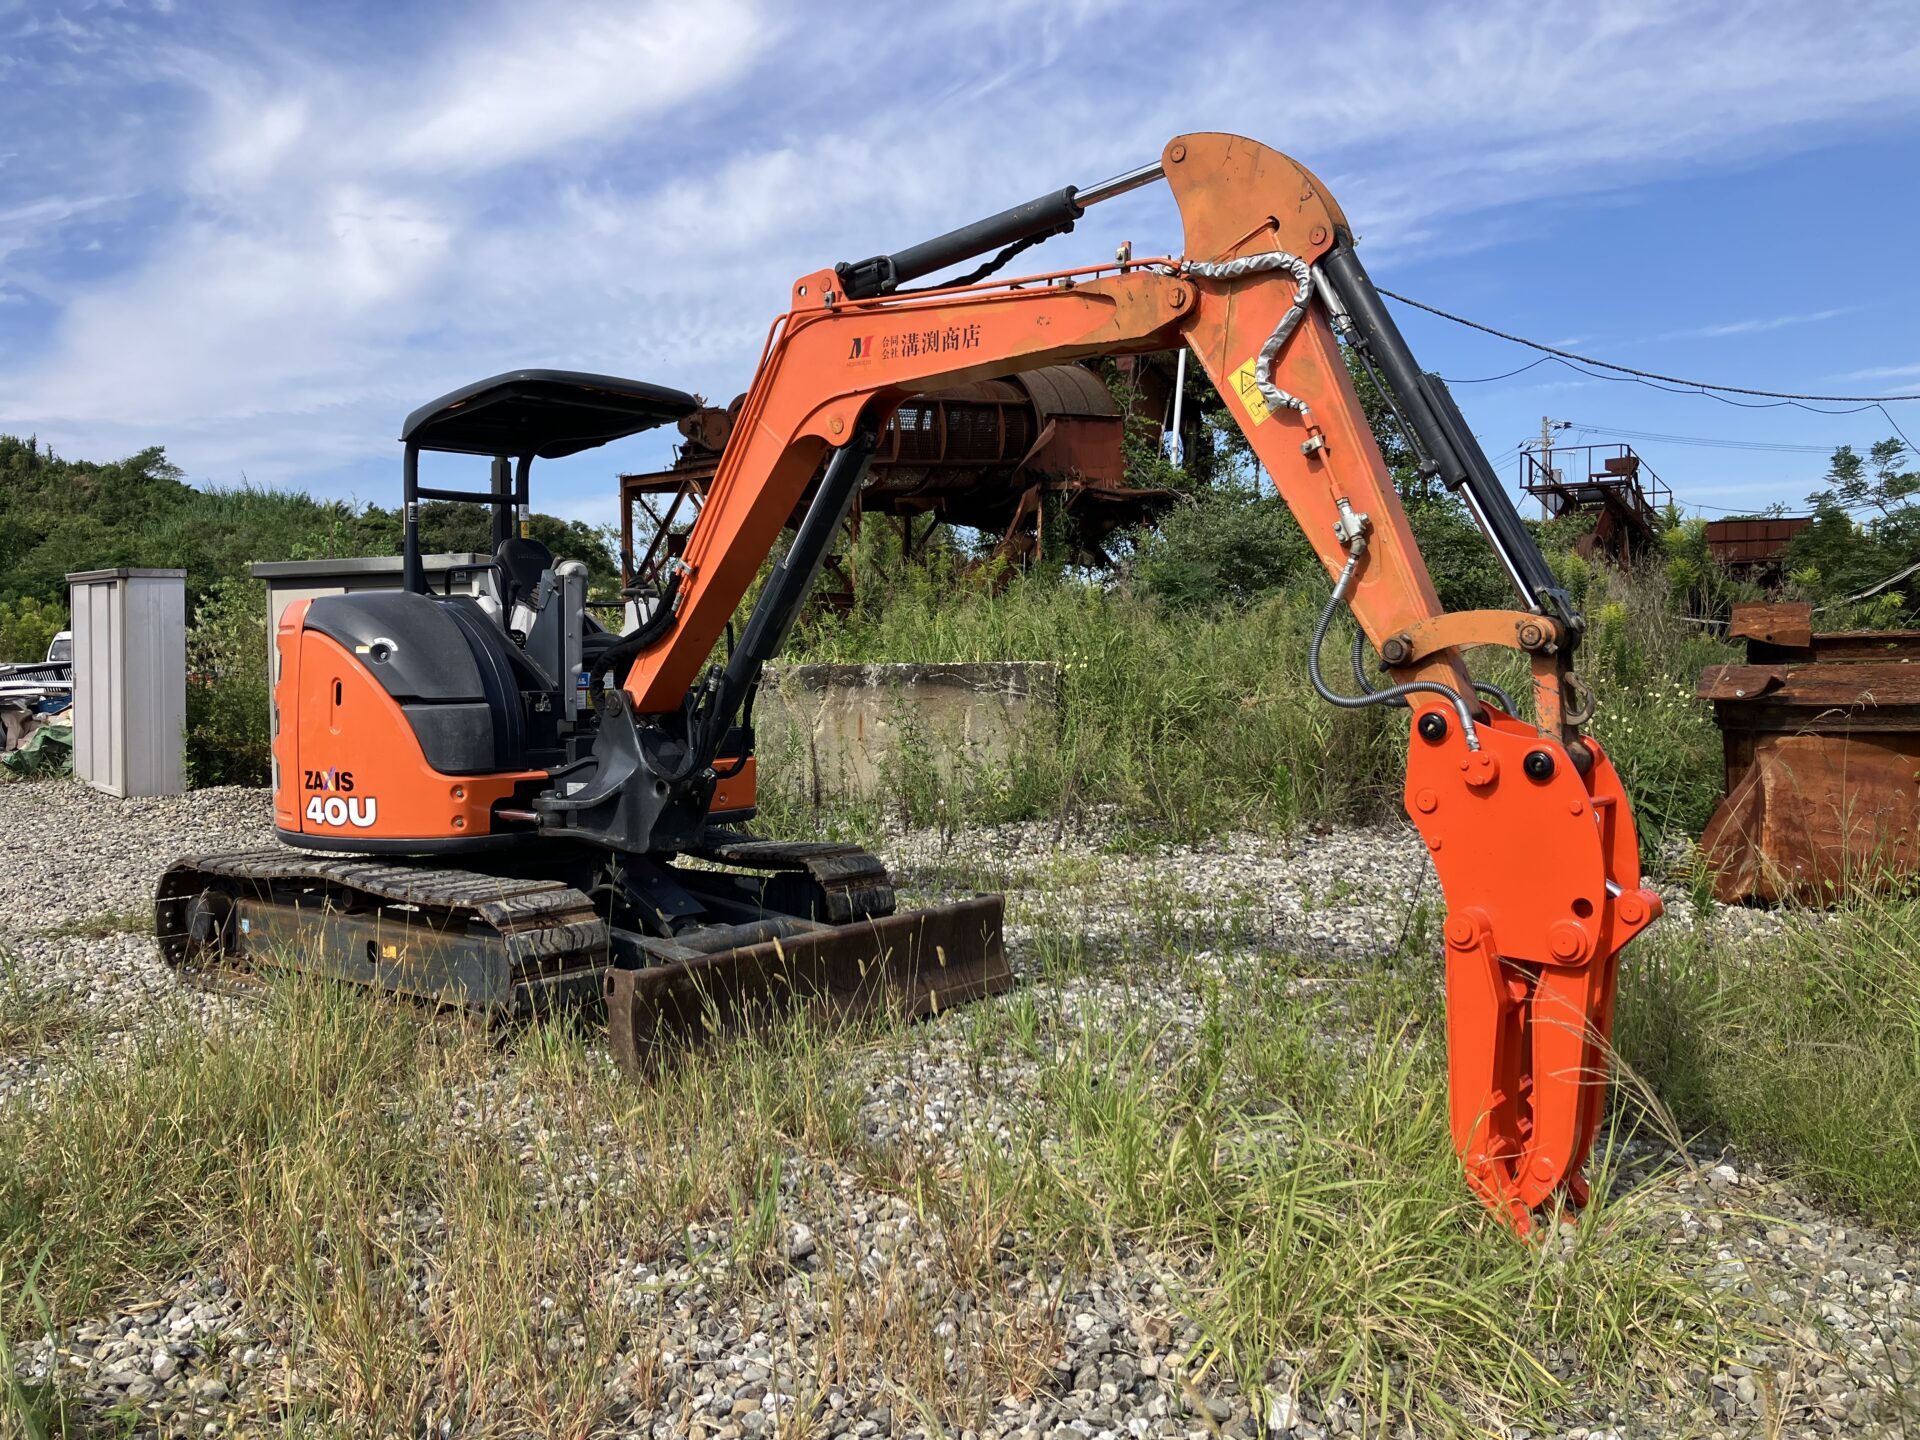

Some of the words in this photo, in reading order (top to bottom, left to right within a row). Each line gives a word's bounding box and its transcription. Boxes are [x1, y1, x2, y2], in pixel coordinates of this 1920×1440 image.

[882, 334, 899, 348] 合同
[882, 347, 899, 360] 会社
[304, 767, 354, 792] ZAXIS
[306, 795, 377, 827] 40U
